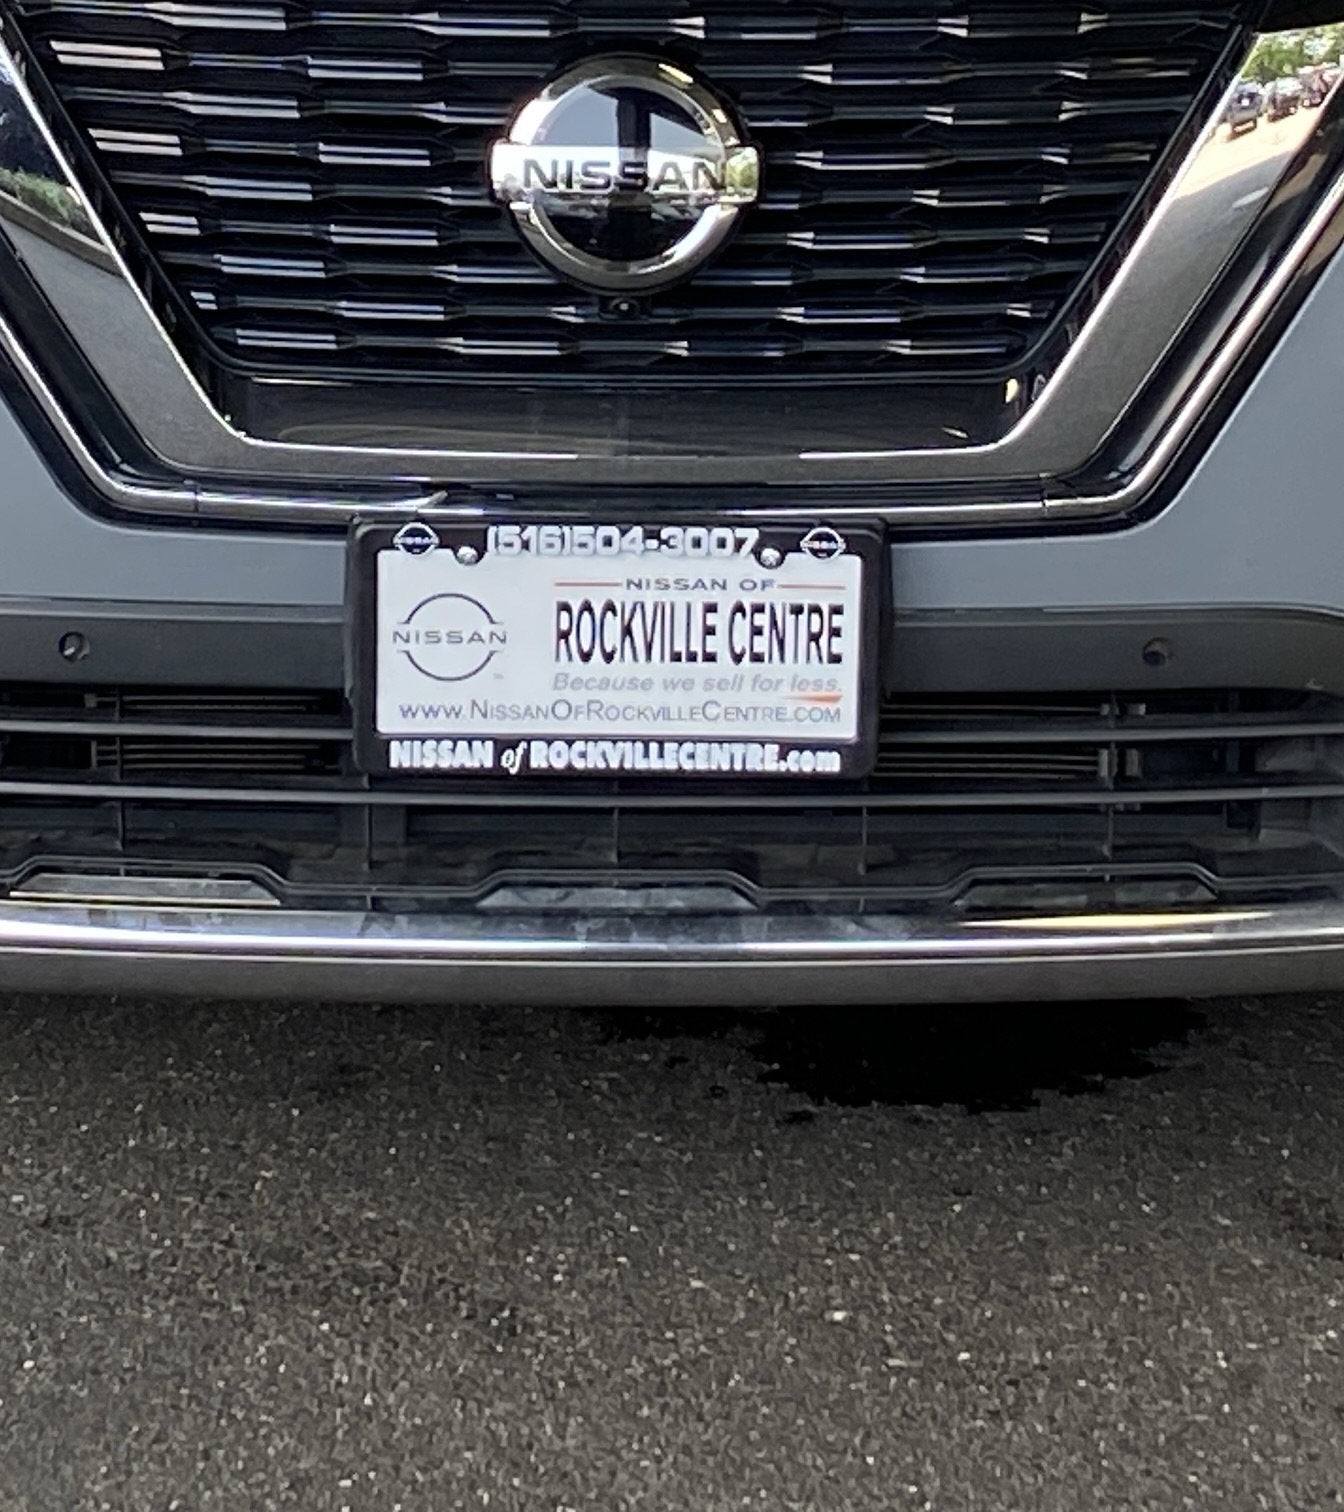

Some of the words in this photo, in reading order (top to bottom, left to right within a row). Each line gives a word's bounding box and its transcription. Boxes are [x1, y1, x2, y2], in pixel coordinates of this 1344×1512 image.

[522, 159, 728, 191] NISSAN
[487, 525, 759, 556] (516)504-3007
[625, 577, 727, 591] NISSAN
[739, 578, 775, 592] OF
[393, 630, 508, 645] NISSAN
[555, 600, 717, 664] ROCKVILLE
[728, 601, 843, 666] CENTRE
[553, 672, 653, 691] Because
[662, 677, 695, 691] we
[705, 674, 744, 692] sell
[750, 674, 784, 693] for
[389, 740, 494, 768] NISSAN
[500, 741, 528, 775] of
